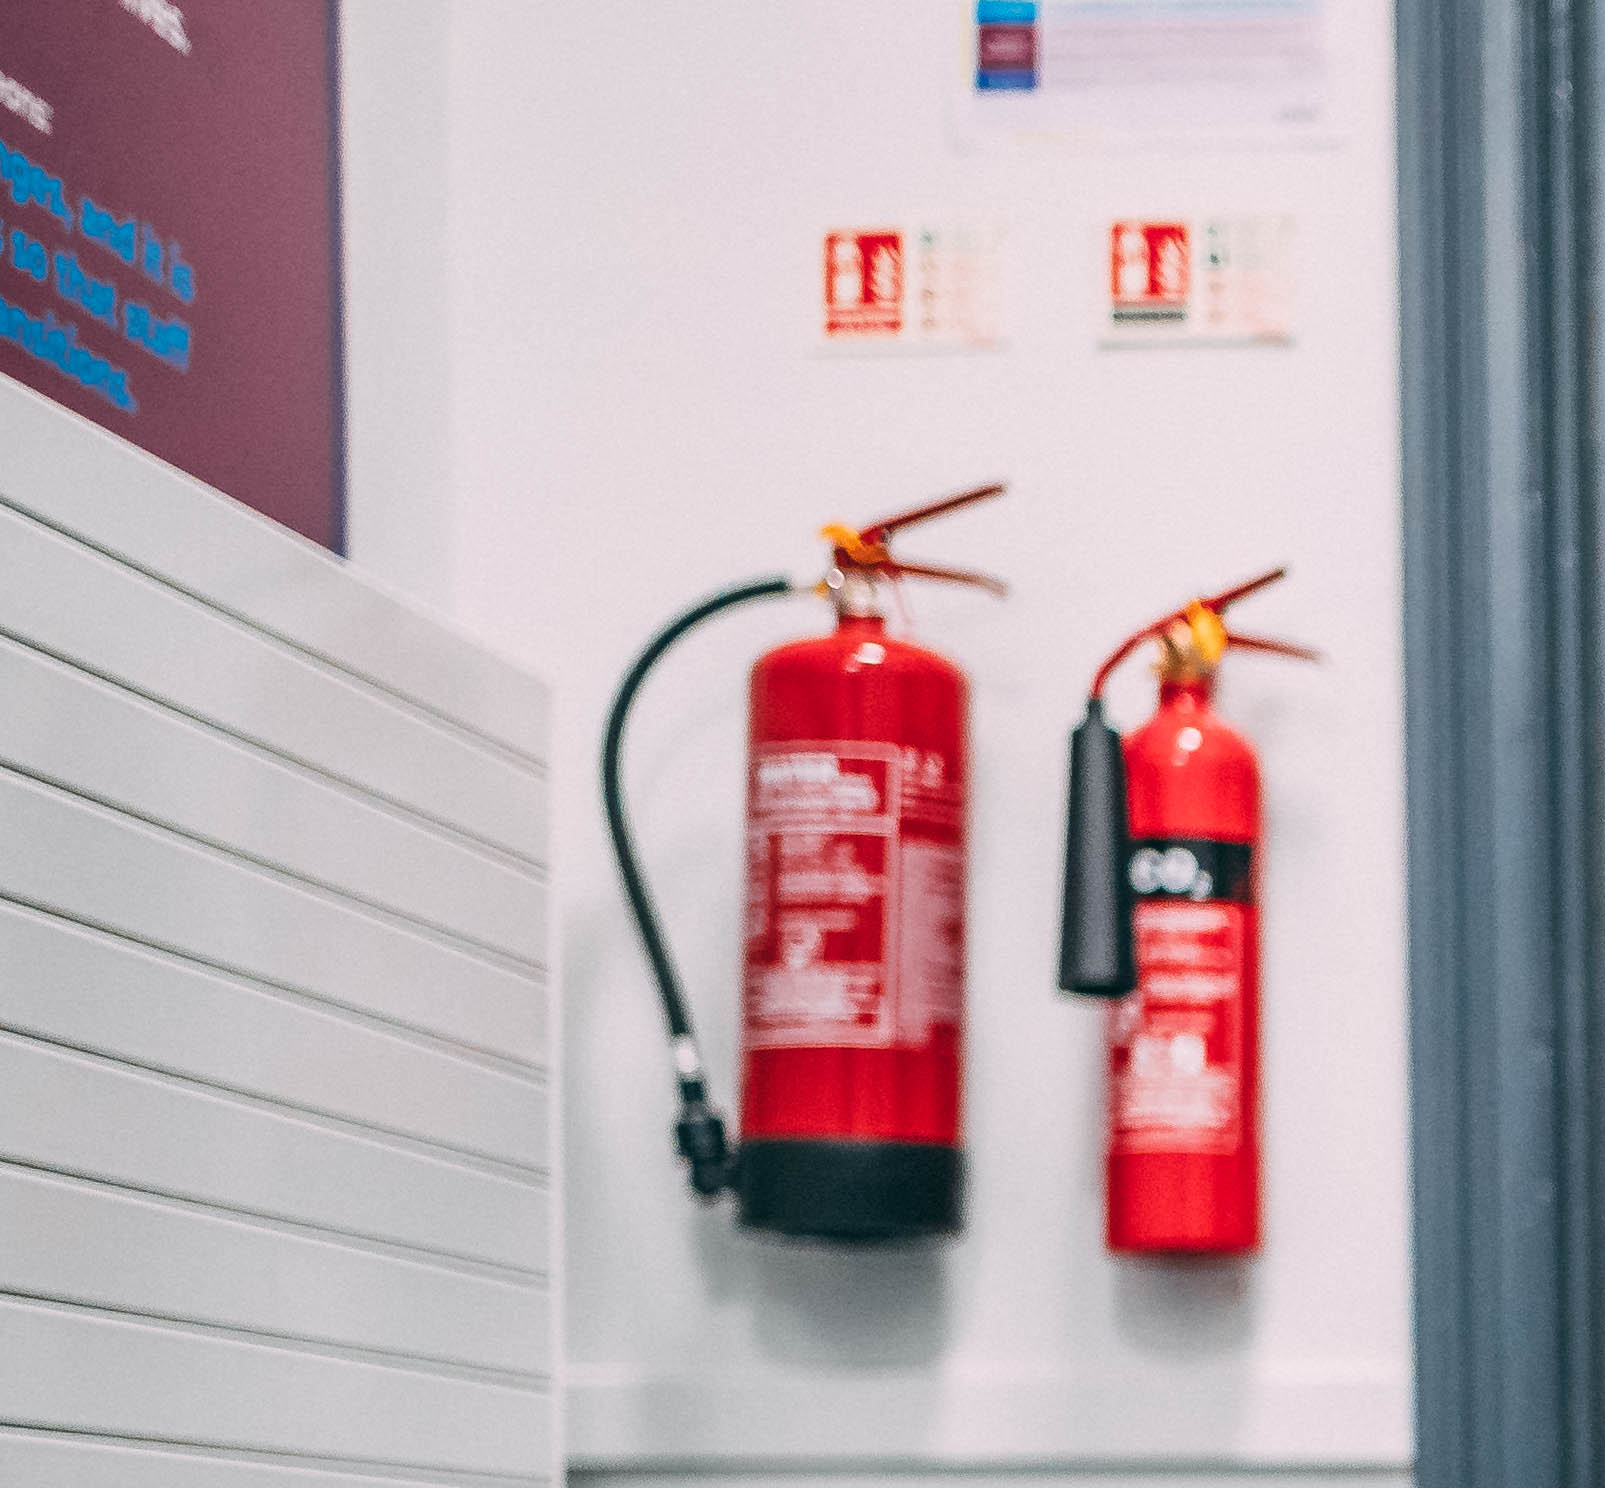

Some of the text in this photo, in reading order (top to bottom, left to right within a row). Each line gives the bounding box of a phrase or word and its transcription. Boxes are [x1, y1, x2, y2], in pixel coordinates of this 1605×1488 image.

[10, 229, 49, 281] so
[54, 250, 117, 329] that
[80, 197, 137, 264] and
[143, 222, 164, 284] it
[169, 242, 195, 301] is
